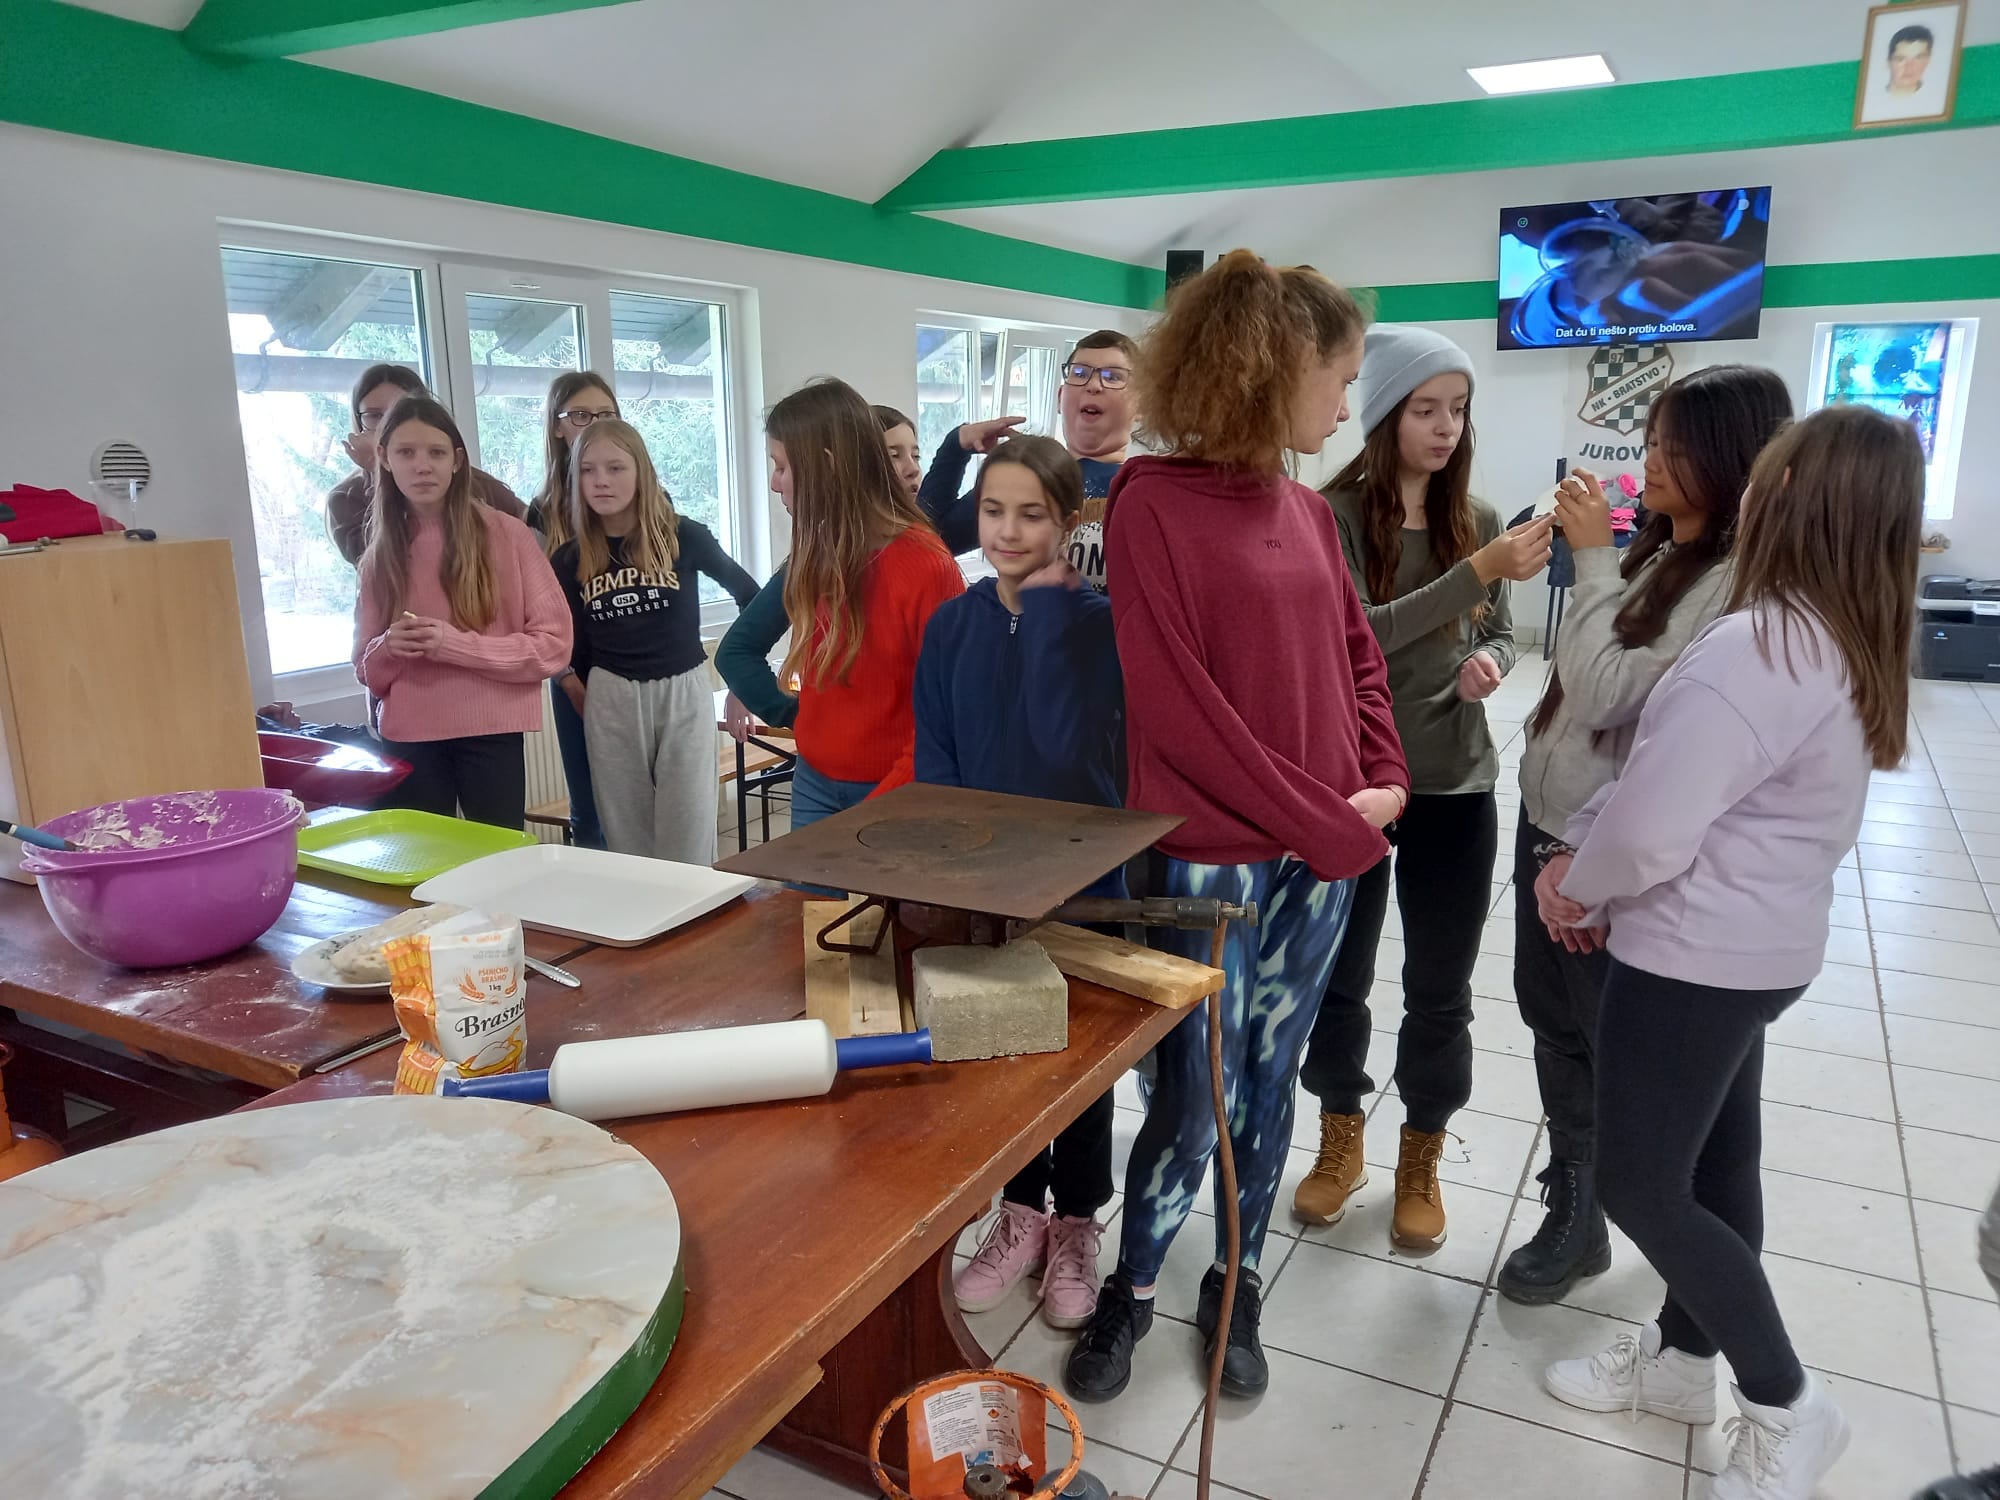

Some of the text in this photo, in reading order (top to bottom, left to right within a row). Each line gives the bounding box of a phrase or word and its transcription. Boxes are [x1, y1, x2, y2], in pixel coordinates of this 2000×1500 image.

[1555, 322, 1697, 338] Dat ću ti nešto protiv bolova.
[1610, 352, 1625, 363] 97
[1591, 367, 1660, 412] NK BRATSTVO
[590, 599, 670, 621] TENNESSEE
[592, 588, 660, 611] 19 USA 51
